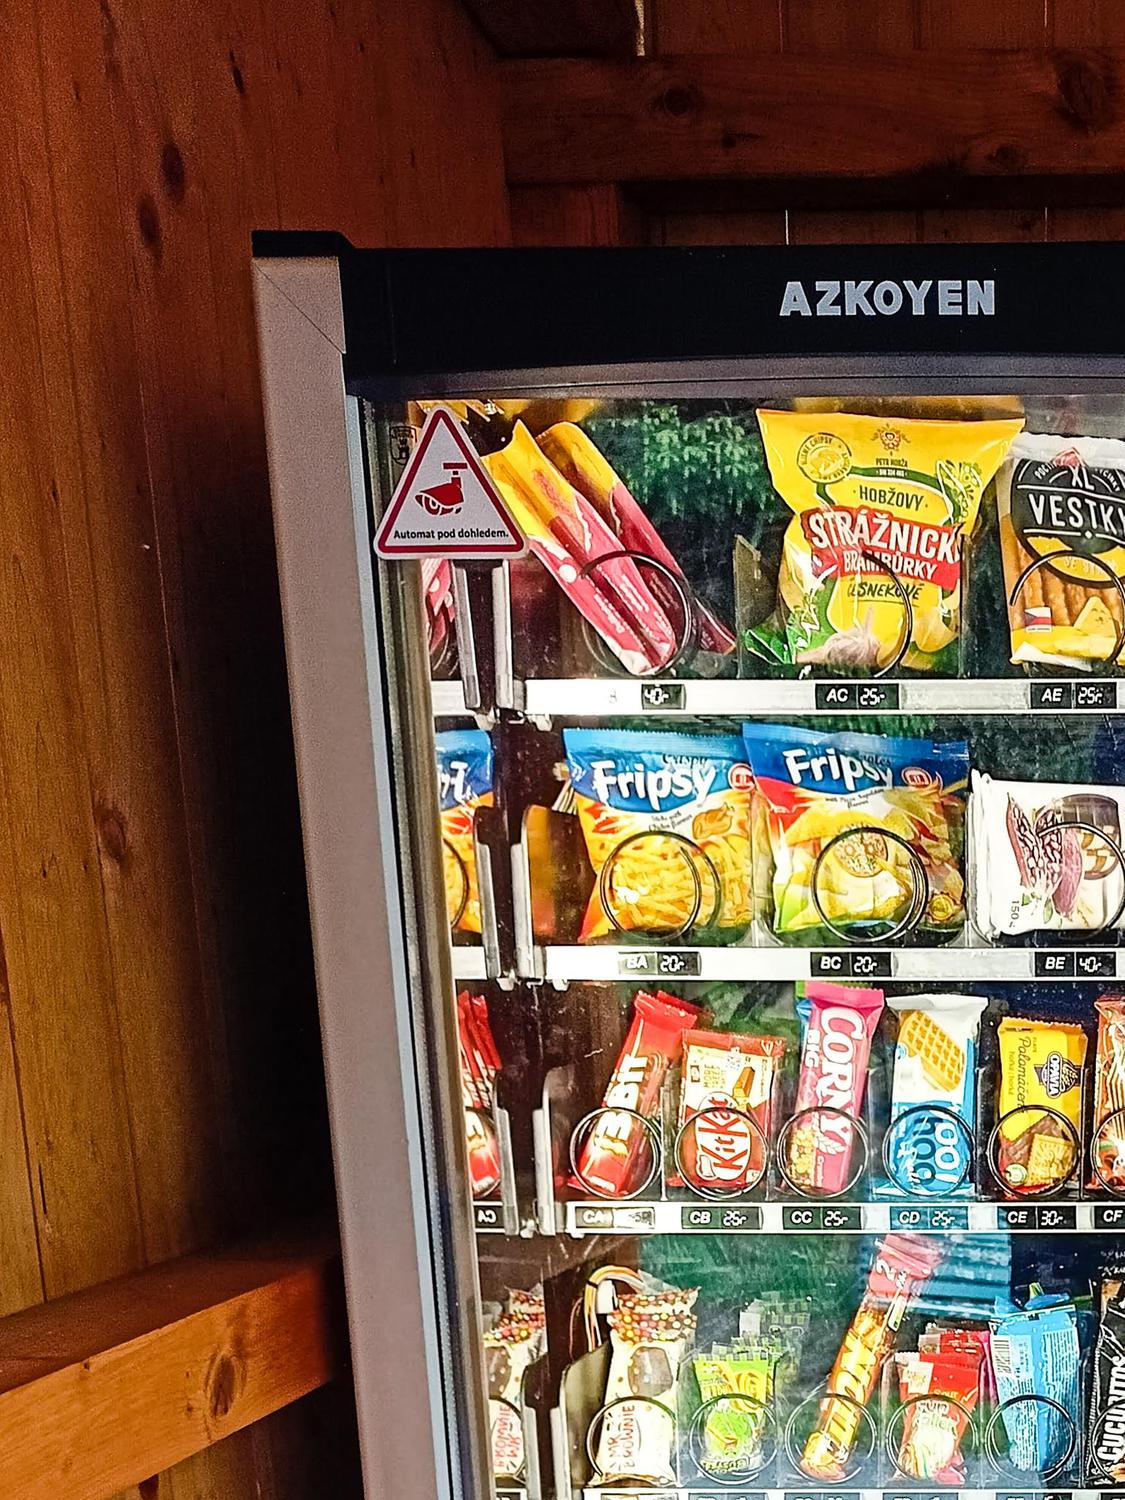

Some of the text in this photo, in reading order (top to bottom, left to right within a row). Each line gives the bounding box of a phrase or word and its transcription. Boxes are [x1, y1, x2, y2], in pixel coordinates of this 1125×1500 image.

[779, 280, 998, 317] AZKOYEN
[859, 484, 924, 512] HOBŽOVY
[393, 528, 509, 540] Automat pod dohledem.
[808, 506, 961, 565] STRÁŽNICK
[826, 689, 849, 702] AC
[1041, 688, 1062, 702] AE
[783, 749, 893, 791] Fripsy
[590, 760, 715, 810] Fripsy
[626, 956, 648, 969] BA
[820, 957, 841, 970] BC
[1045, 957, 1065, 970] BE
[805, 1029, 820, 1068] BIG
[816, 1006, 864, 1147] CORNY
[1048, 1055, 1061, 1095] OPAVIA
[689, 1211, 712, 1224] CB
[790, 1211, 813, 1224] CC
[899, 1211, 920, 1224] CD
[1007, 1211, 1028, 1224] CE
[1103, 1209, 1123, 1222] CF
